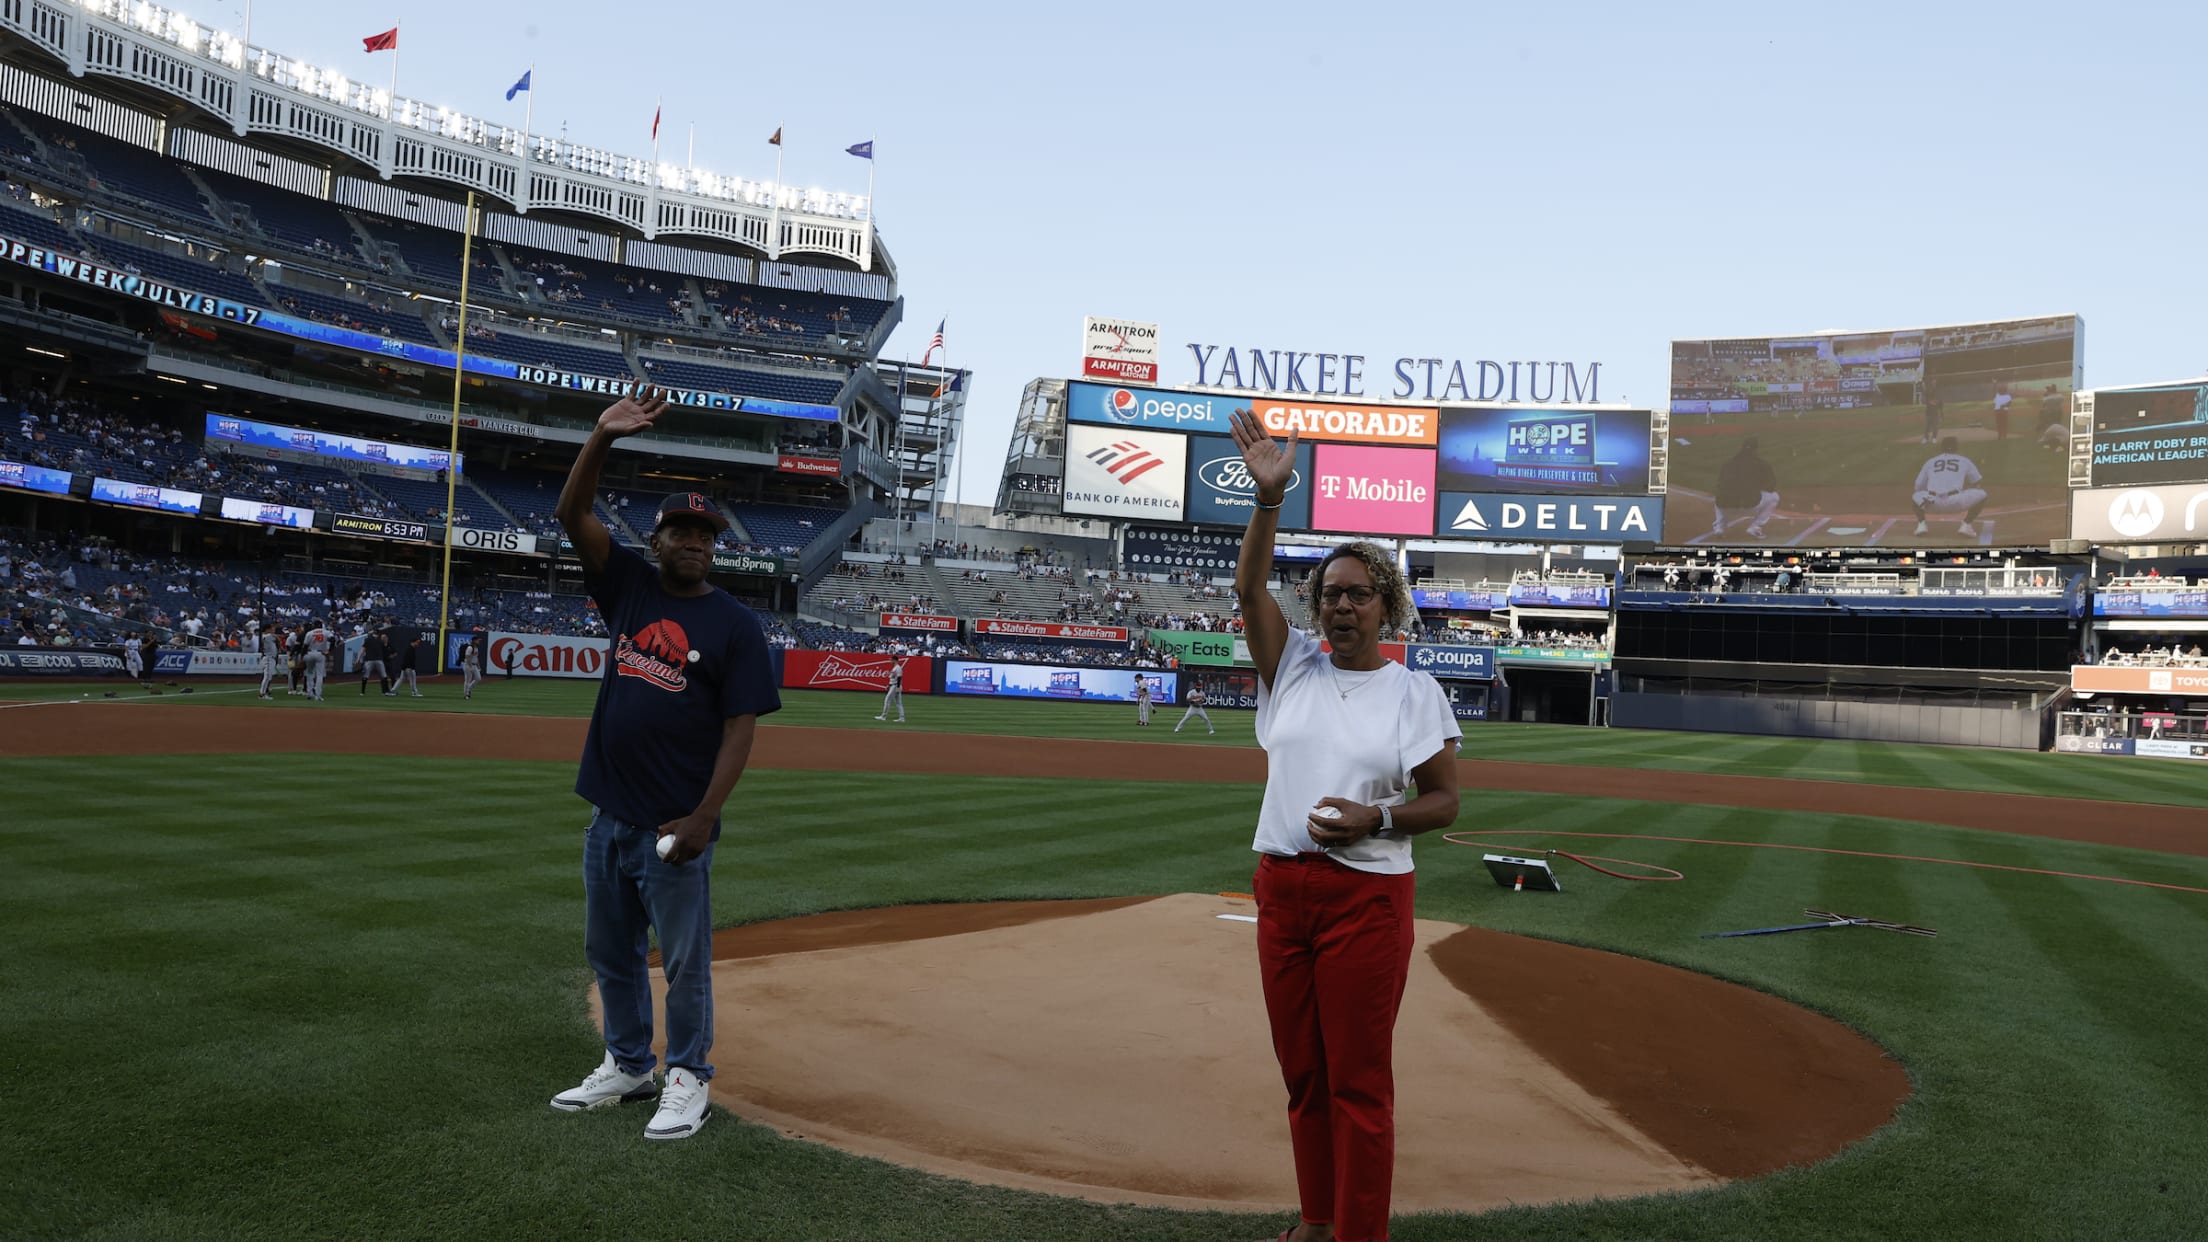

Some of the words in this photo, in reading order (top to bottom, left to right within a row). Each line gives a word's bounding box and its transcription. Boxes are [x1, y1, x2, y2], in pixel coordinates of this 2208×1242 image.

[57, 256, 127, 291] WEEK
[134, 283, 193, 308] JULY
[203, 298, 215, 314] 3
[246, 309, 259, 325] 7
[1089, 323, 1156, 338] ARMITRON
[1091, 360, 1151, 374] ARMITRON
[1186, 343, 1365, 397] YANKEE
[1392, 357, 1602, 404] STADIUM
[519, 366, 571, 387] HOPE
[581, 376, 632, 396] WEEK
[696, 393, 707, 406] 3
[732, 398, 742, 411] 7
[1143, 399, 1214, 423] pepsi
[480, 419, 518, 433] YANKEES
[519, 425, 540, 436] CLUB
[1264, 406, 1425, 437] GATORADE
[1509, 422, 1587, 446] HOPE
[2094, 443, 2109, 453] OF
[2112, 440, 2151, 452] LARRY
[2154, 438, 2187, 450] DOBY
[2190, 436, 2208, 447] BR
[323, 456, 377, 472] LANDING
[2093, 452, 2155, 465] AMERICAN
[2158, 448, 2208, 461] LEAGUE'
[797, 461, 839, 472] Budweiser
[1934, 459, 1959, 472] 95
[1538, 468, 1569, 481] PERSEVERE
[1578, 471, 1598, 482] EXCEL
[1346, 476, 1426, 503] Mobile
[1066, 491, 1101, 502] BANK
[1104, 494, 1120, 504] OF
[1123, 496, 1180, 508] AMERICA
[1215, 497, 1256, 507] BuyFordNo
[1502, 502, 1647, 531] DELTA
[336, 517, 383, 532] ARMITRON
[384, 523, 407, 536] 6:53
[462, 529, 519, 550] ORIS
[742, 556, 775, 573] Spring
[2109, 594, 2139, 603] HOPE
[2175, 594, 2207, 603] HOPE
[420, 631, 436, 641] 318
[1192, 641, 1230, 657] Eats
[45, 655, 76, 668] COOL
[157, 655, 187, 668] ACC
[1436, 652, 1484, 669] coupa
[819, 661, 890, 678] Budweise
[963, 669, 991, 678] HOPE
[1051, 673, 1078, 682] HOPE
[1457, 708, 1484, 716] CLEAR
[2087, 741, 2124, 750] CLEAR
